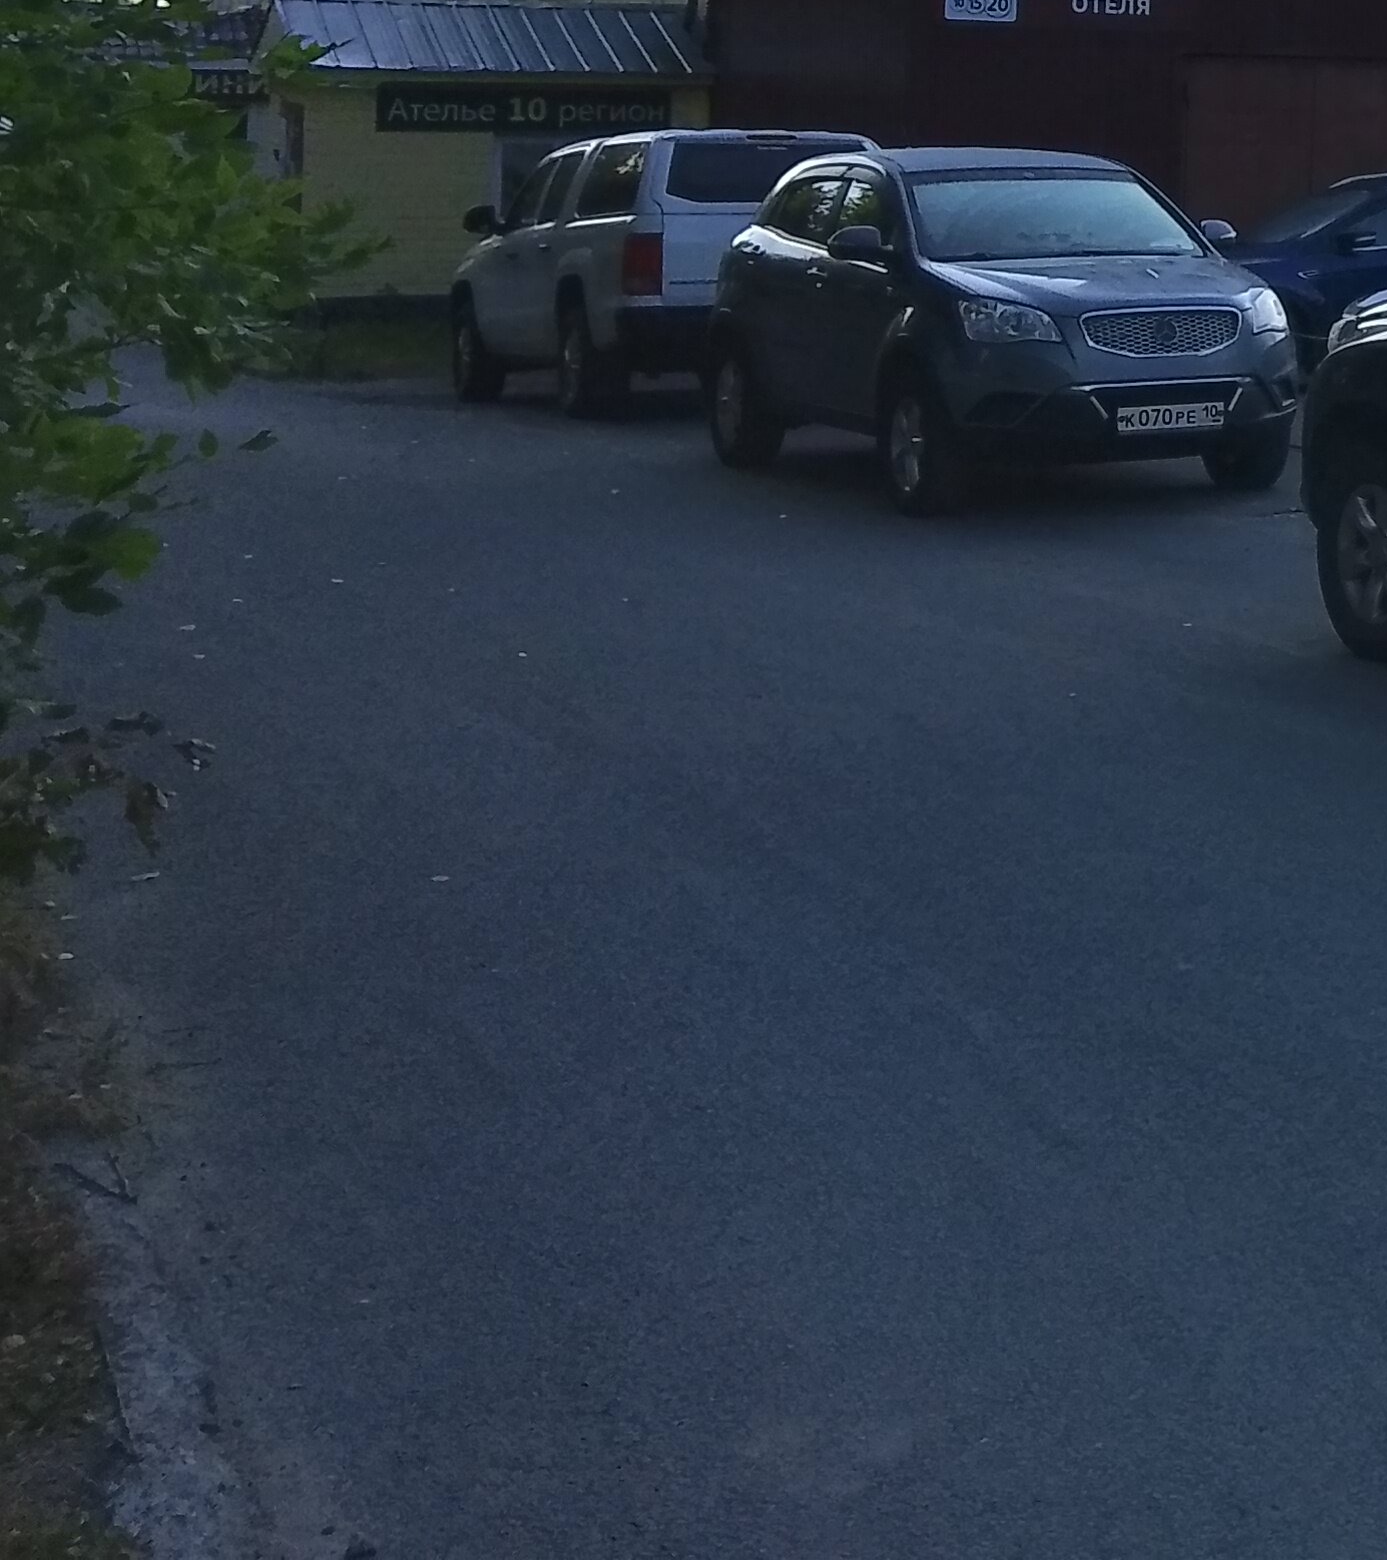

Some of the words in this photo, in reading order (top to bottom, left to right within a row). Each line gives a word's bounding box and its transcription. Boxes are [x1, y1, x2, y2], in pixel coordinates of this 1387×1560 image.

[387, 96, 496, 122] Ателье
[509, 96, 547, 122] 10
[559, 102, 664, 128] регион
